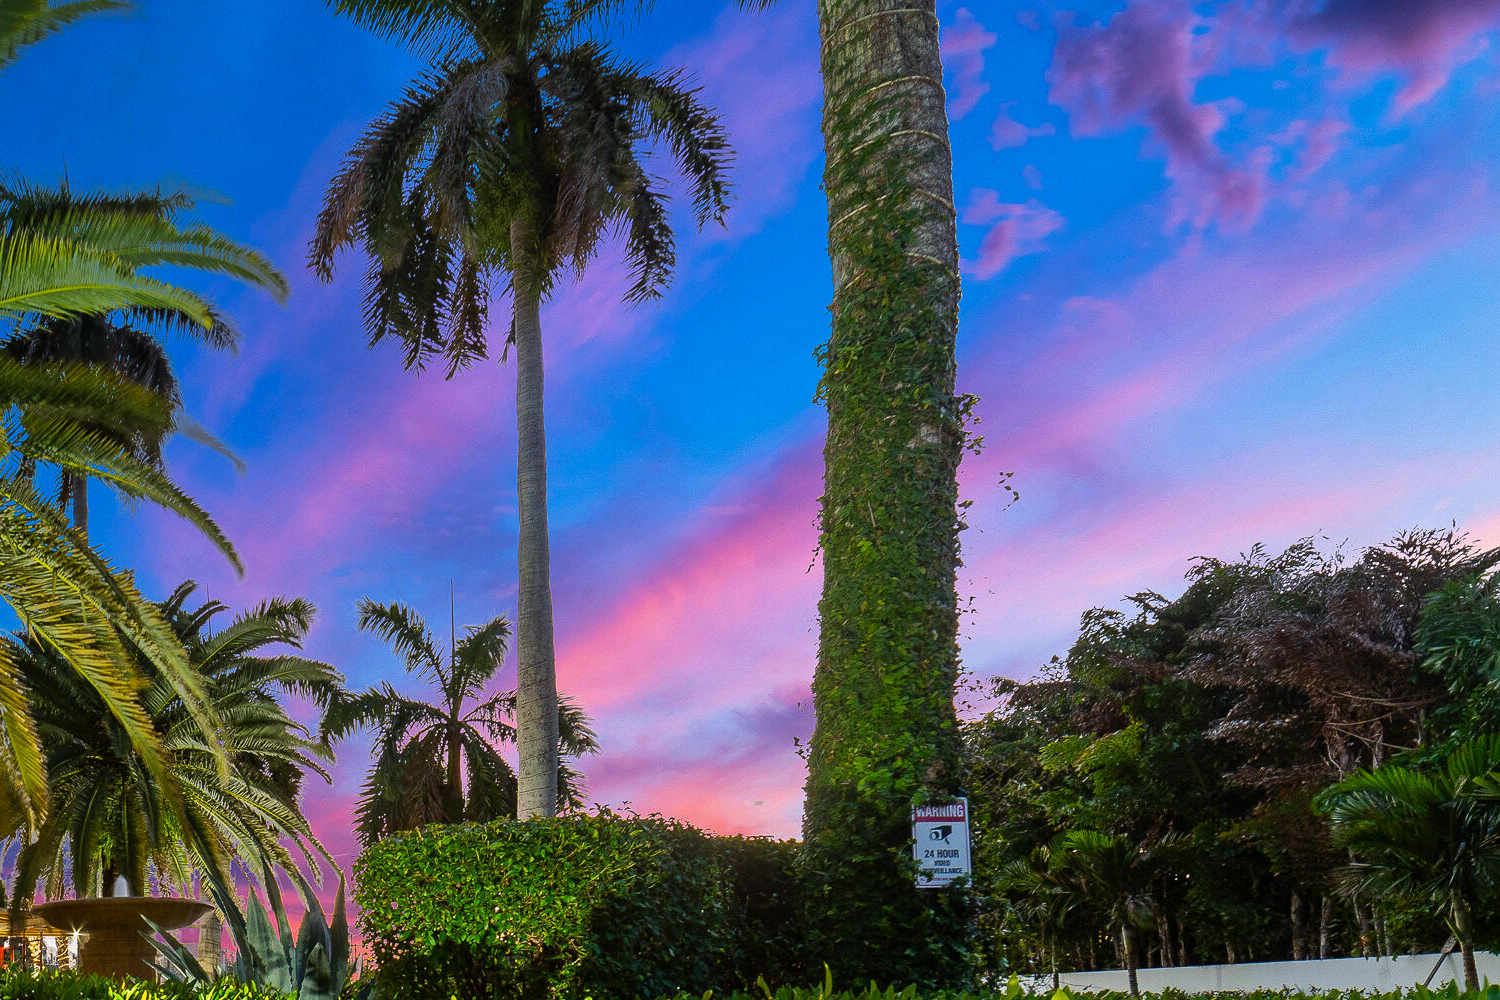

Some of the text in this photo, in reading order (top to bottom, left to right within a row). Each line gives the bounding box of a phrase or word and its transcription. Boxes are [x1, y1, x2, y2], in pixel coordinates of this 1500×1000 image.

[916, 804, 964, 817] WARNING
[924, 849, 959, 859] 24 HOUR
